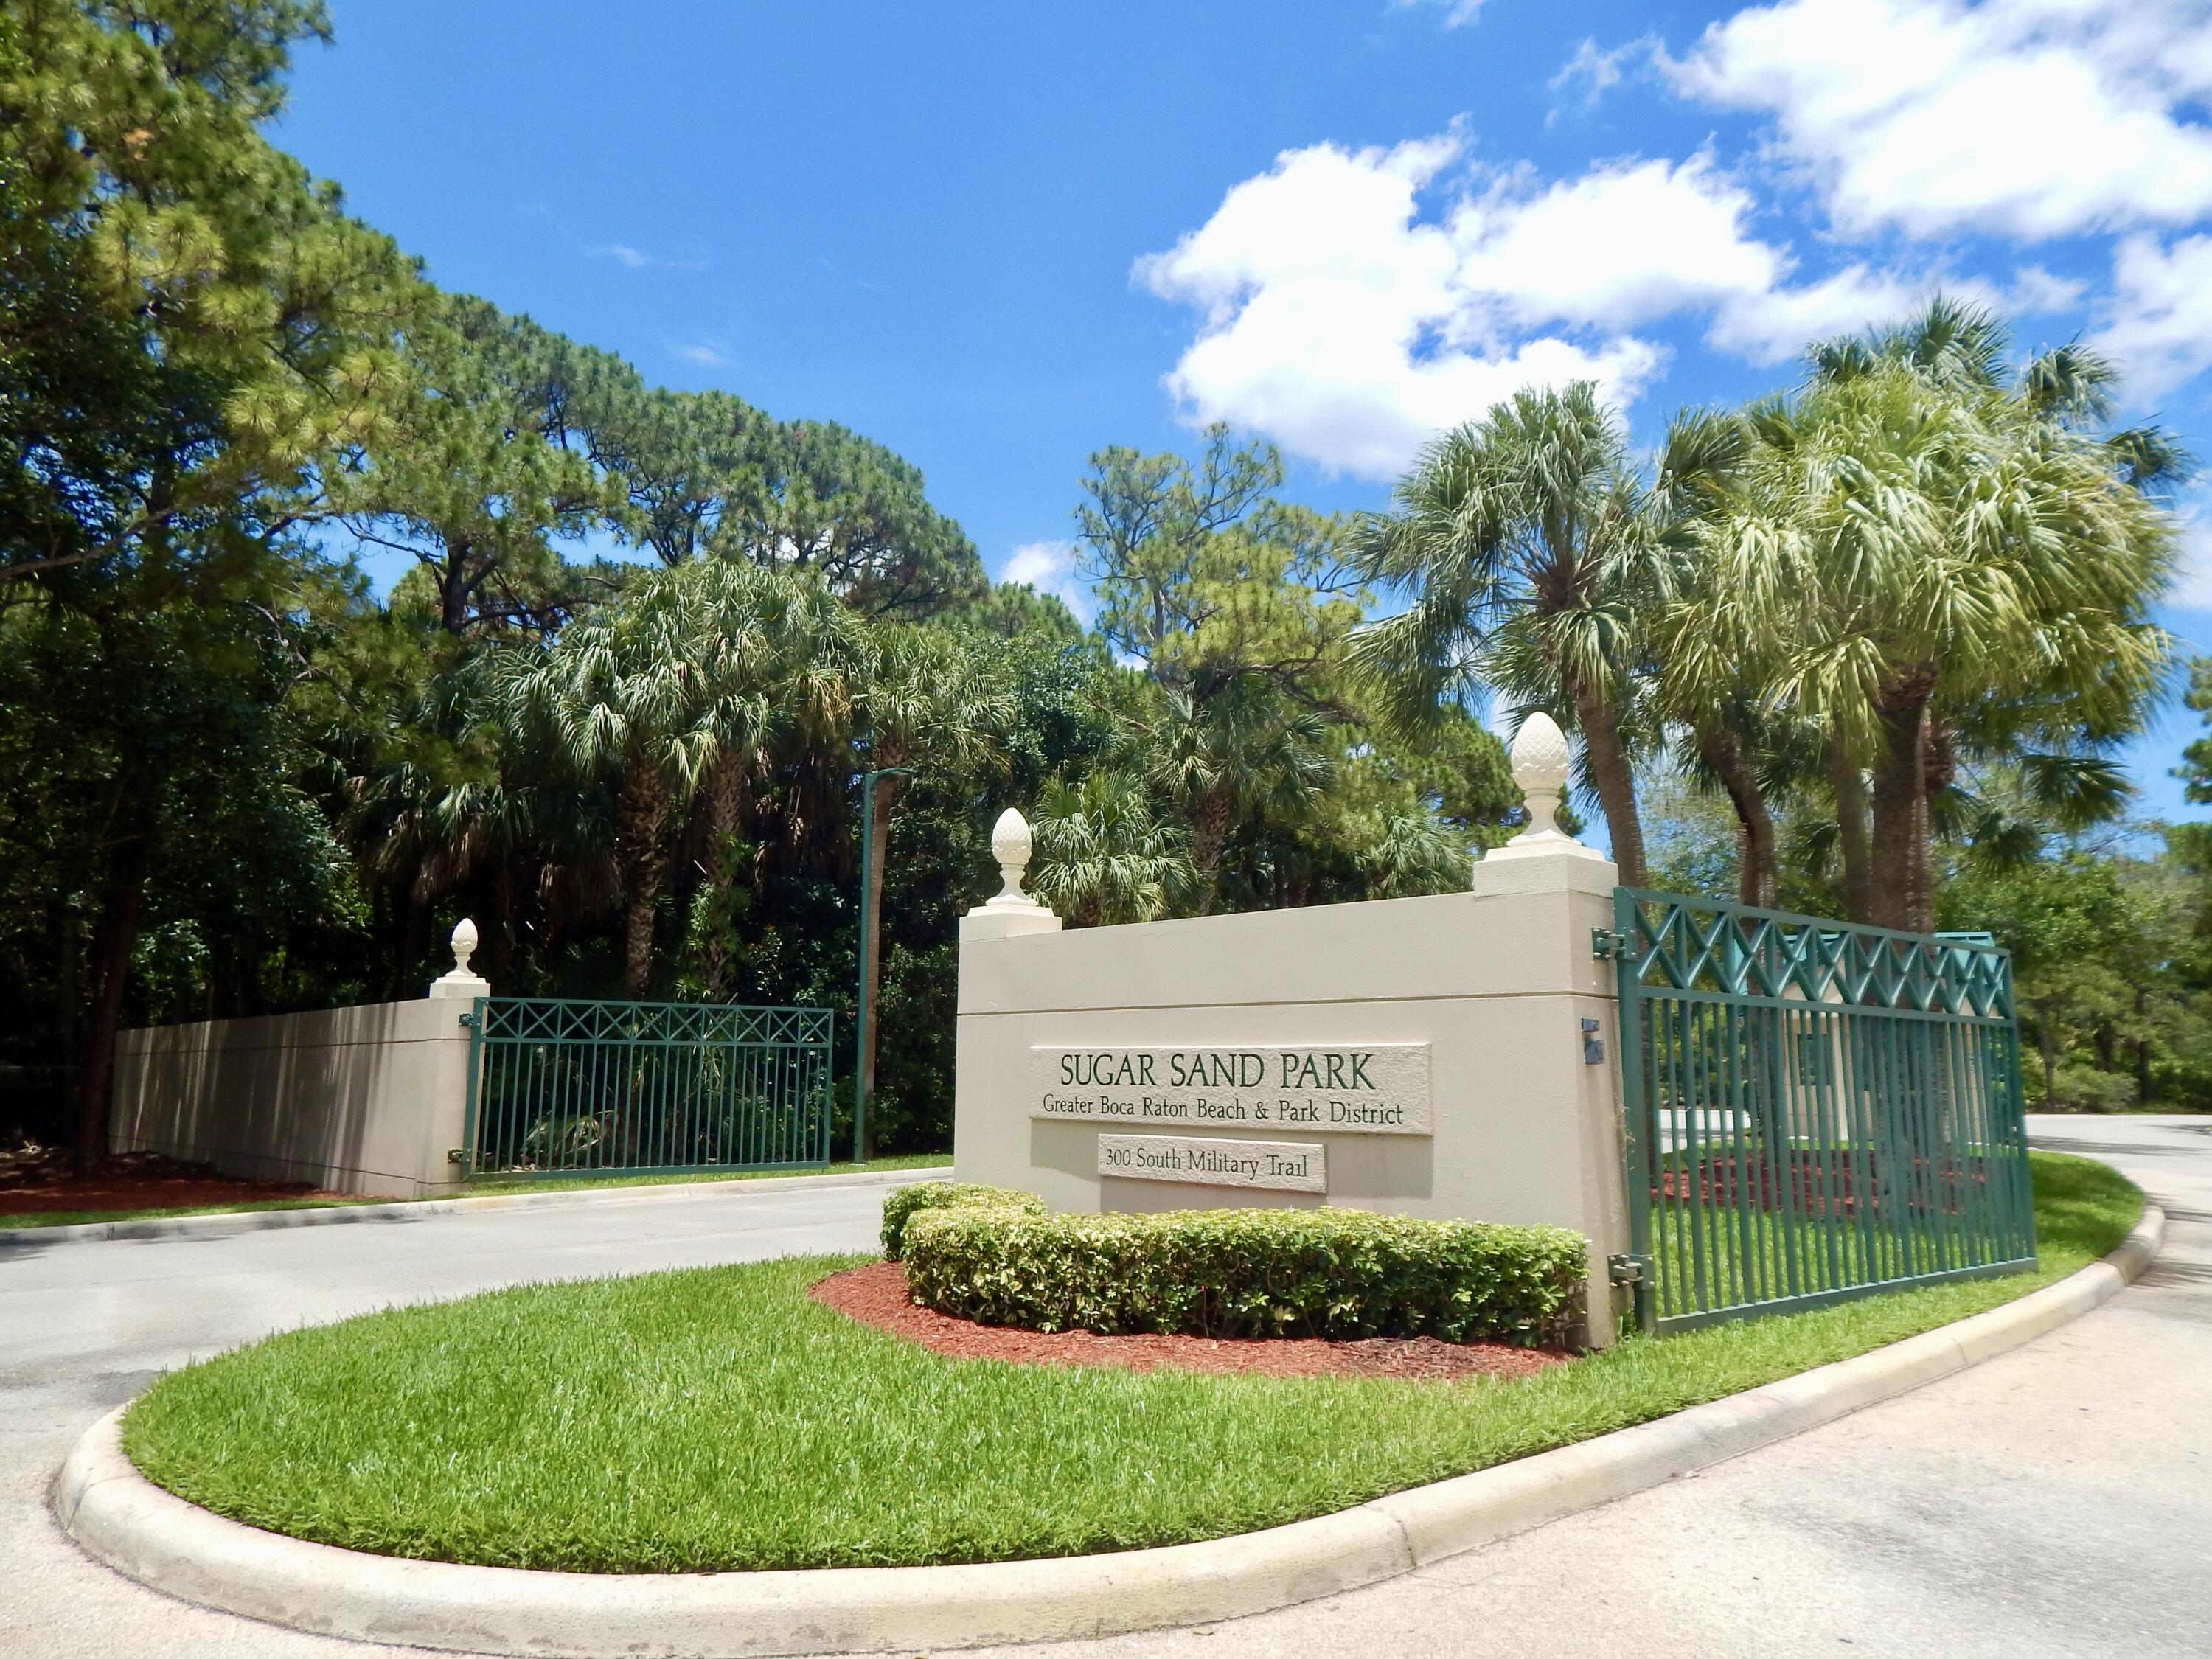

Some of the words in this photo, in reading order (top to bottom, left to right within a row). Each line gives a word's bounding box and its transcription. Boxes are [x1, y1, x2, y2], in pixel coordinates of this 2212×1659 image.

[1060, 1054, 1157, 1085] SUGAR
[1170, 1053, 1265, 1087] SAND
[1281, 1053, 1376, 1089] PARK
[1043, 1093, 1093, 1113] Greater
[1100, 1096, 1134, 1115] Boca
[1142, 1097, 1188, 1116] Raton
[1197, 1098, 1245, 1119] Beach
[1255, 1101, 1269, 1119] &
[1279, 1099, 1320, 1121] Park
[1329, 1101, 1403, 1124] District
[1105, 1148, 1131, 1166] 300
[1136, 1148, 1180, 1169] South
[1188, 1150, 1259, 1180] Military
[1266, 1155, 1307, 1177] Trail
